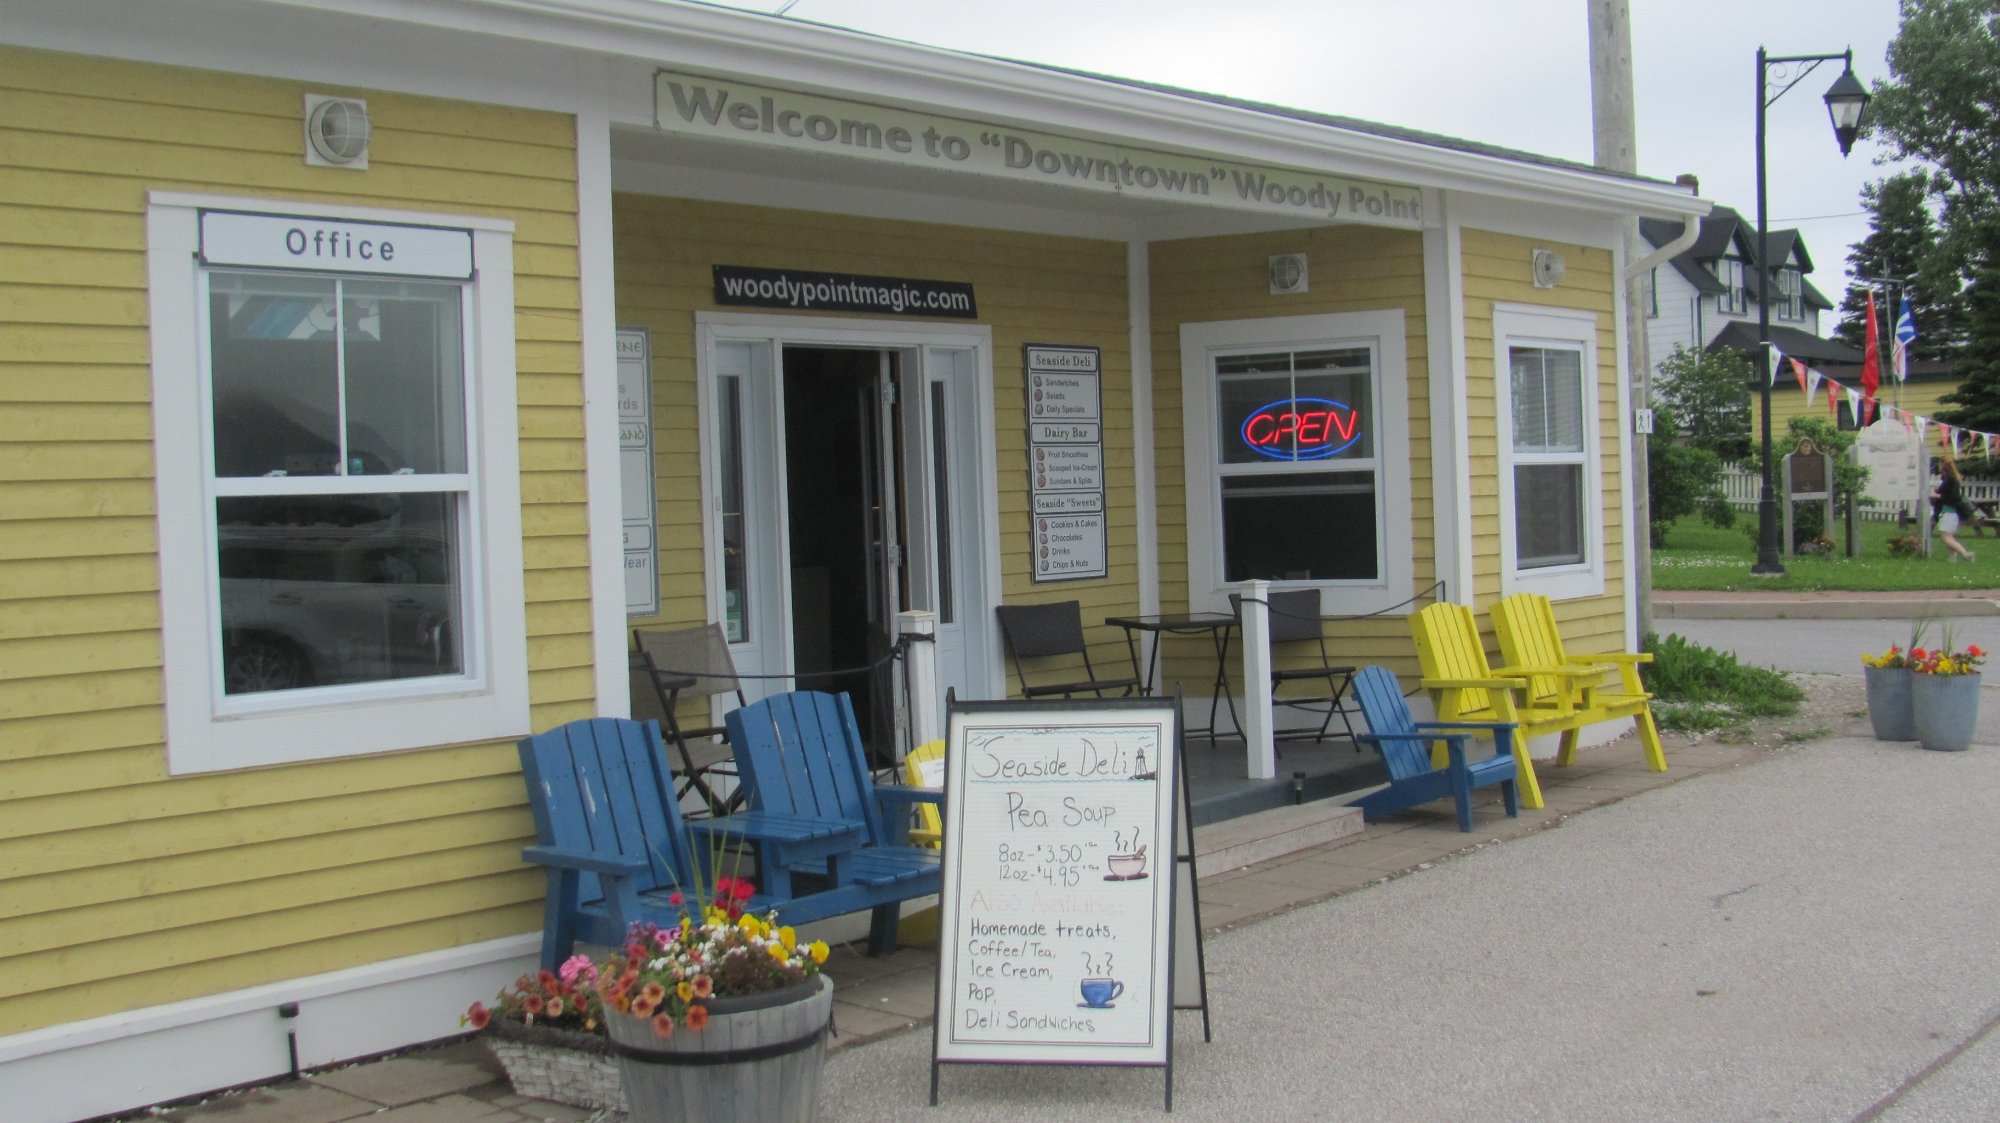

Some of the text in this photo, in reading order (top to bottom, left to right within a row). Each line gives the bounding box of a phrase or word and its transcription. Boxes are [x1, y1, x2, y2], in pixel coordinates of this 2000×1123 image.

[666, 80, 1420, 220] Welcome to “Downtown” Woody Point
[286, 228, 394, 261] Office
[723, 275, 970, 312] woodypointmagic.com
[1035, 354, 1091, 367] Seaside Deli
[1045, 378, 1079, 387] Sandwiches
[1046, 392, 1065, 400] Salads
[1046, 405, 1085, 414] Daily Specials
[1044, 427, 1088, 440] Dairy Bar
[1246, 410, 1358, 445] OPEN
[1048, 464, 1071, 473] Scooped
[1036, 498, 1065, 508] Seaside
[1051, 521, 1074, 529] Cookies
[1081, 519, 1097, 527] Cakes
[1051, 534, 1083, 542] Chocolates
[1052, 547, 1070, 555] Drinks
[1052, 560, 1069, 570] Chips
[1076, 559, 1089, 567] Nuts
[972, 736, 1127, 778] Seaside Deli
[1006, 791, 1116, 831] Pea Soup
[970, 917, 1117, 940] Homemade treats,
[971, 959, 1053, 979] Ice Cream,
[966, 1009, 1000, 1029] Deli
